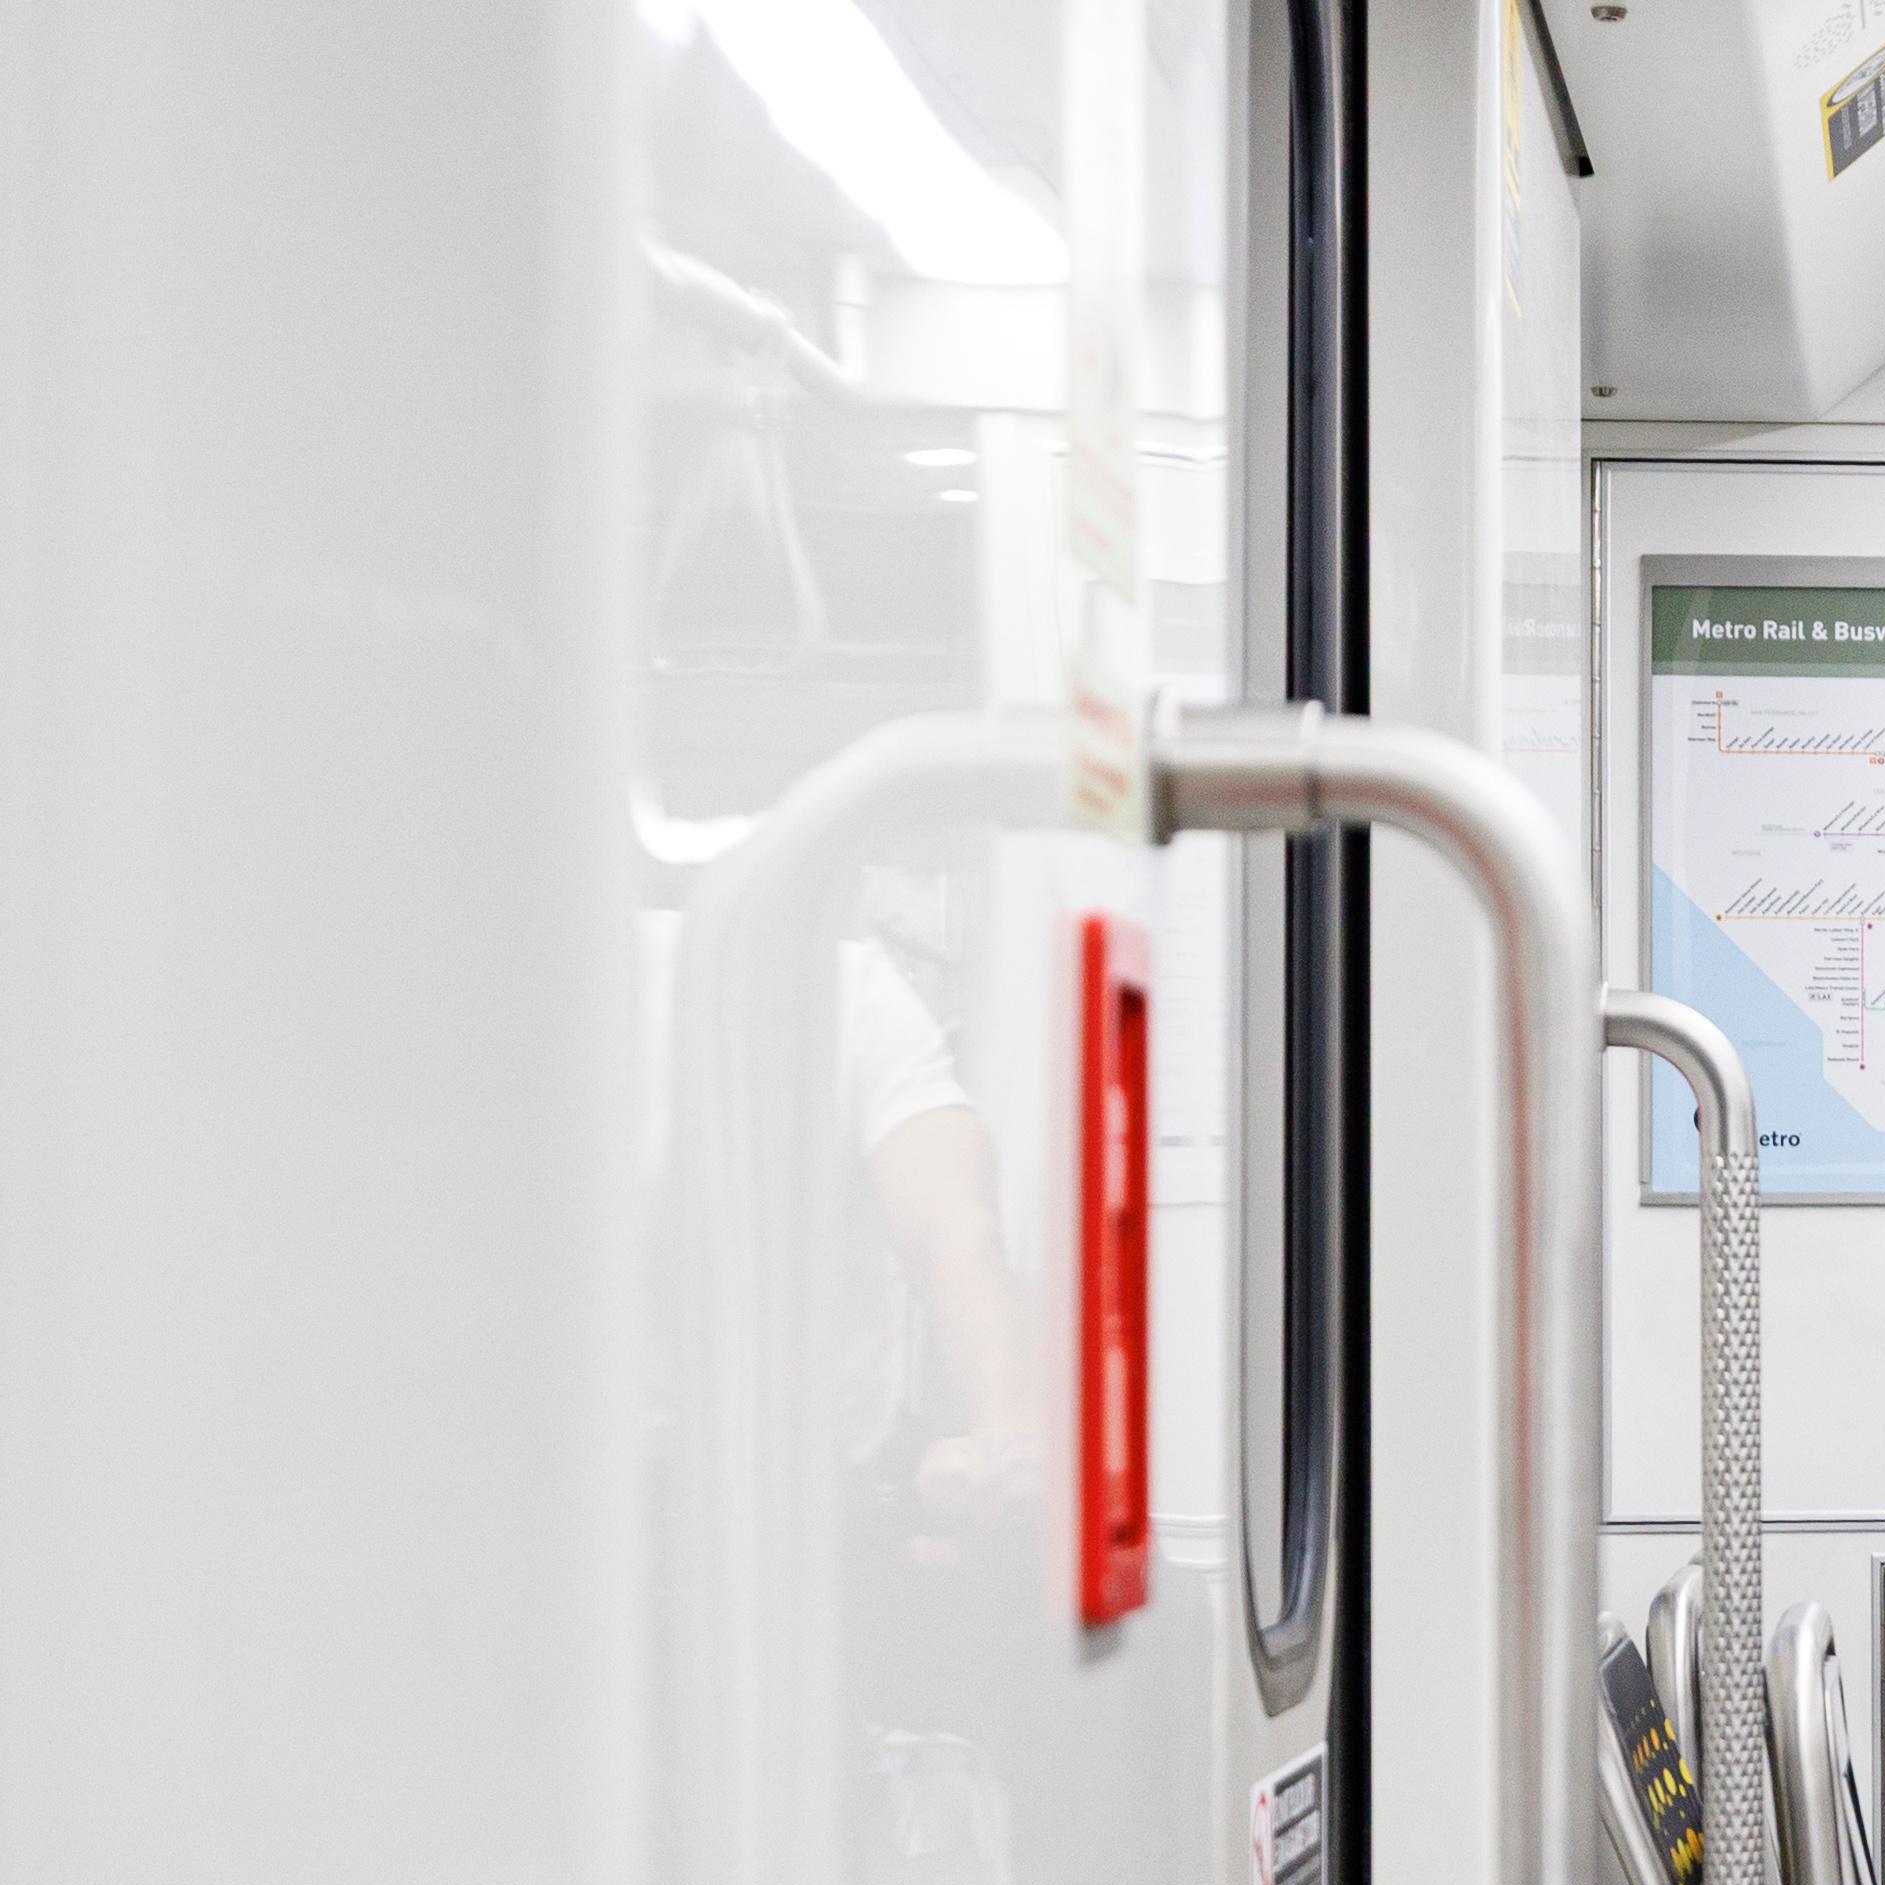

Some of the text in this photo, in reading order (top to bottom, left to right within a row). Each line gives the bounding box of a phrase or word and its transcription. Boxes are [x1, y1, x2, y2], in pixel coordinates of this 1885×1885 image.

[1692, 618, 1757, 639] Metro
[1762, 619, 1806, 640] Rail
[1811, 620, 1829, 641] &
[1759, 1130, 1801, 1147] etro
